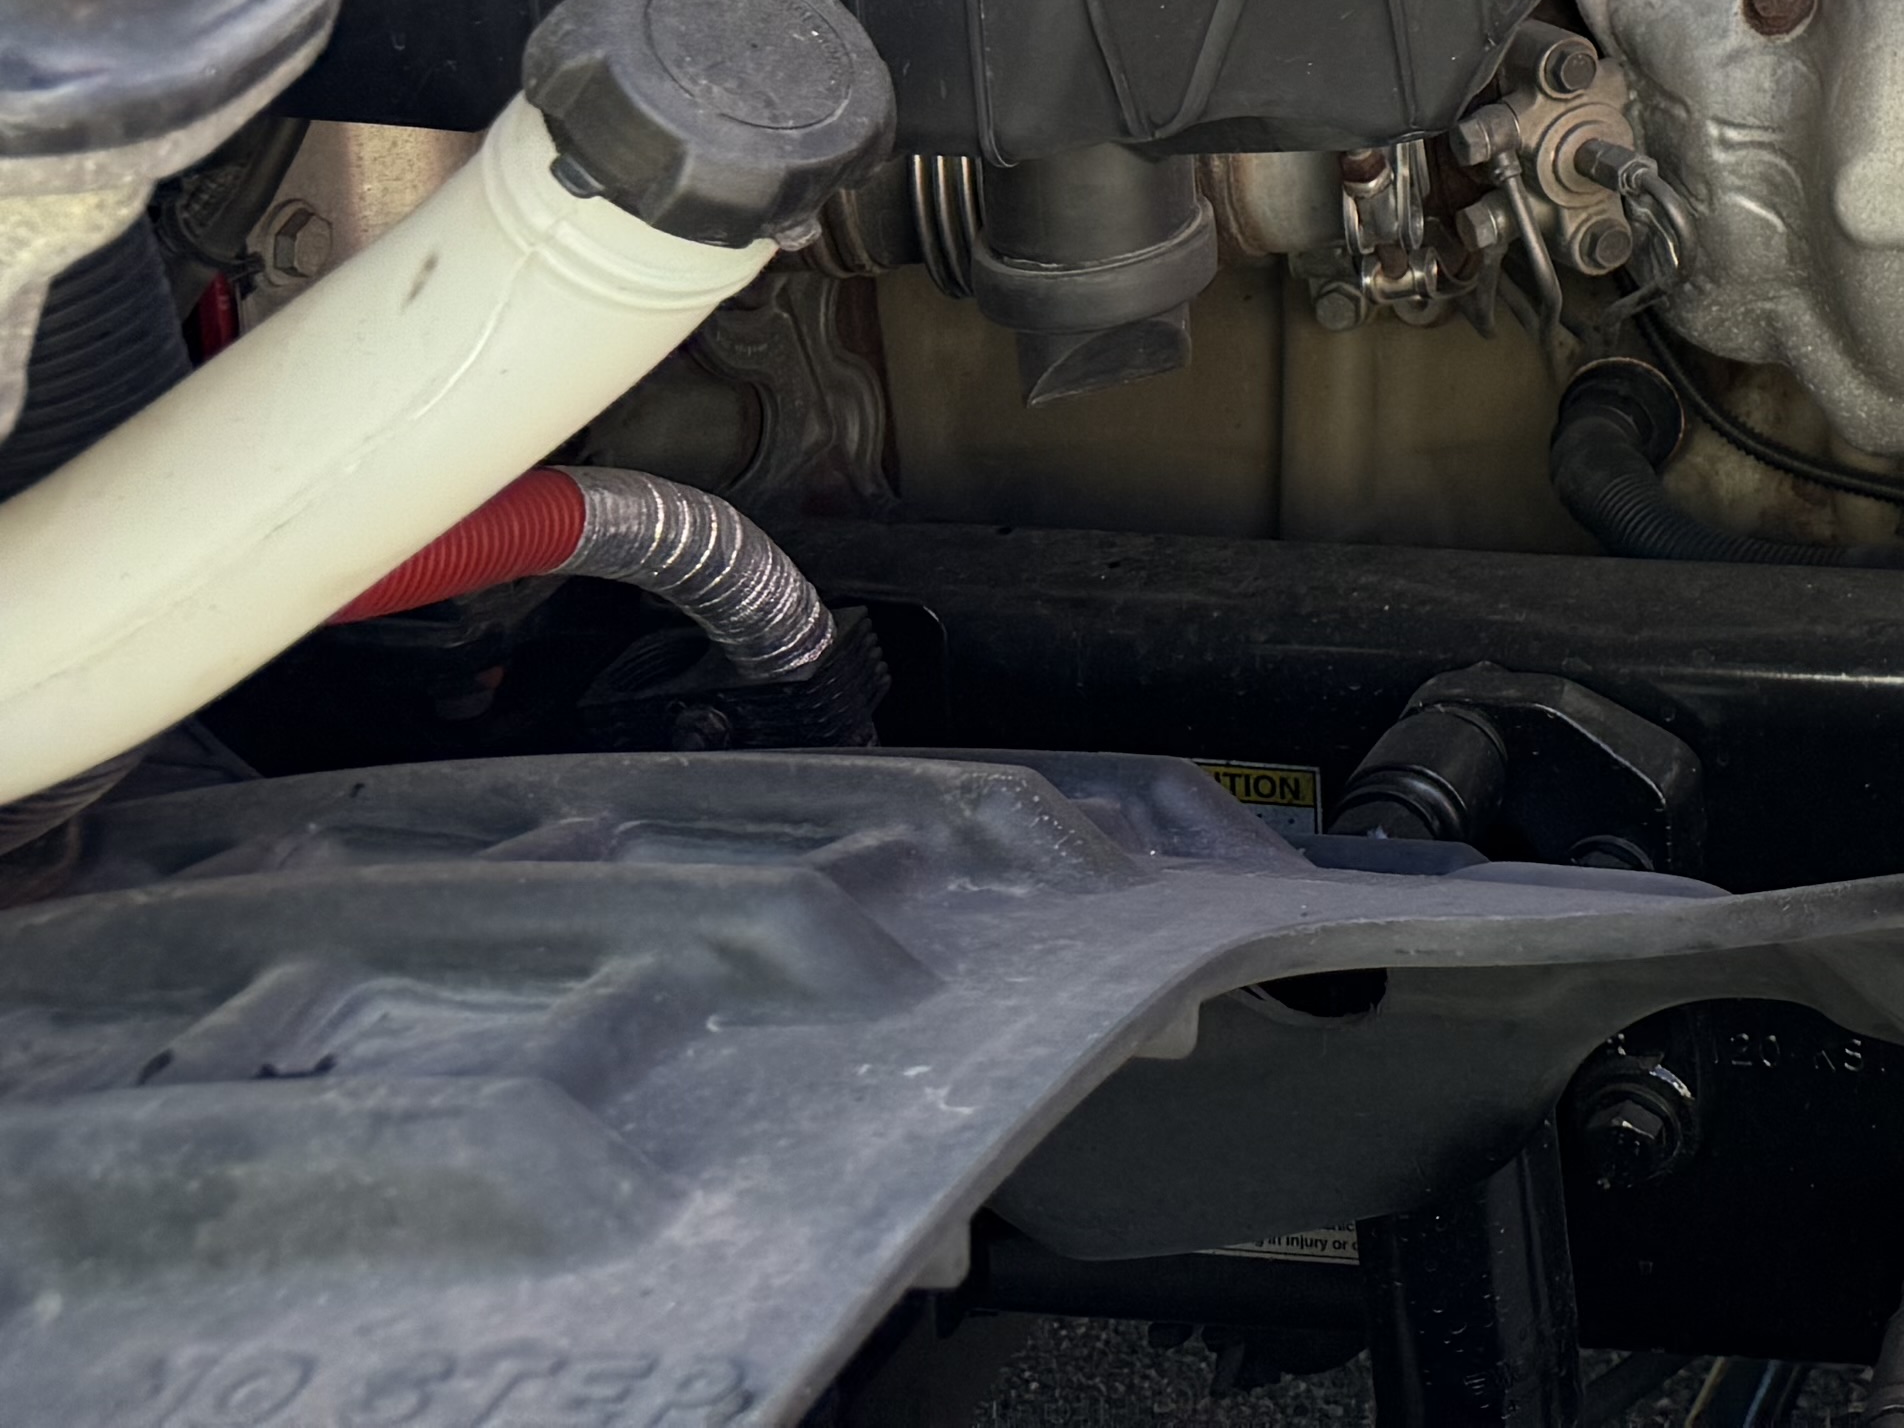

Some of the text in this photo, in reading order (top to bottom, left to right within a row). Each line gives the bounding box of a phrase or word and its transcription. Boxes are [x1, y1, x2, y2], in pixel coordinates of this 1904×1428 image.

[1214, 771, 1301, 801] TION
[1286, 1234, 1328, 1252] injury
[1332, 1238, 1348, 1251] or
